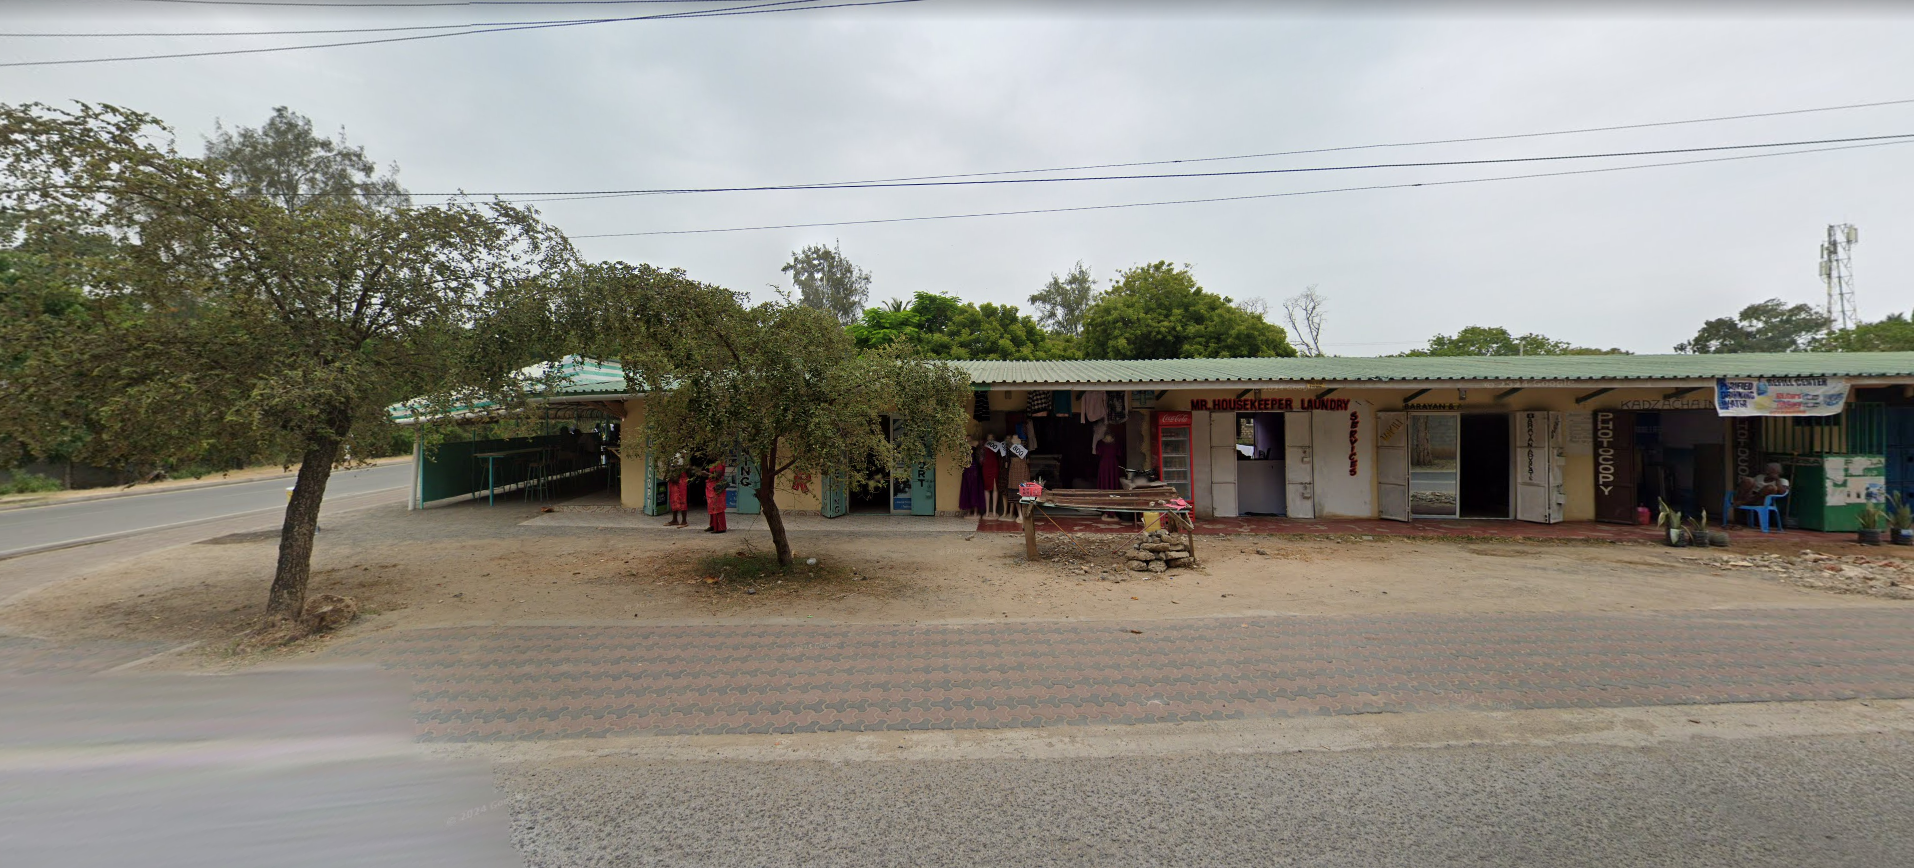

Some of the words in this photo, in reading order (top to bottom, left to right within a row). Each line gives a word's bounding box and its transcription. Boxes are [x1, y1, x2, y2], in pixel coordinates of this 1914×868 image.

[1796, 378, 1828, 387] CENTER
[1190, 398, 1211, 411] MR.
[1212, 397, 1294, 411] HOUSEKEEPER
[1300, 397, 1350, 411] LAUNDRY
[1348, 411, 1360, 477] SERVICES
[1597, 412, 1615, 496] PHOTOCOPY
